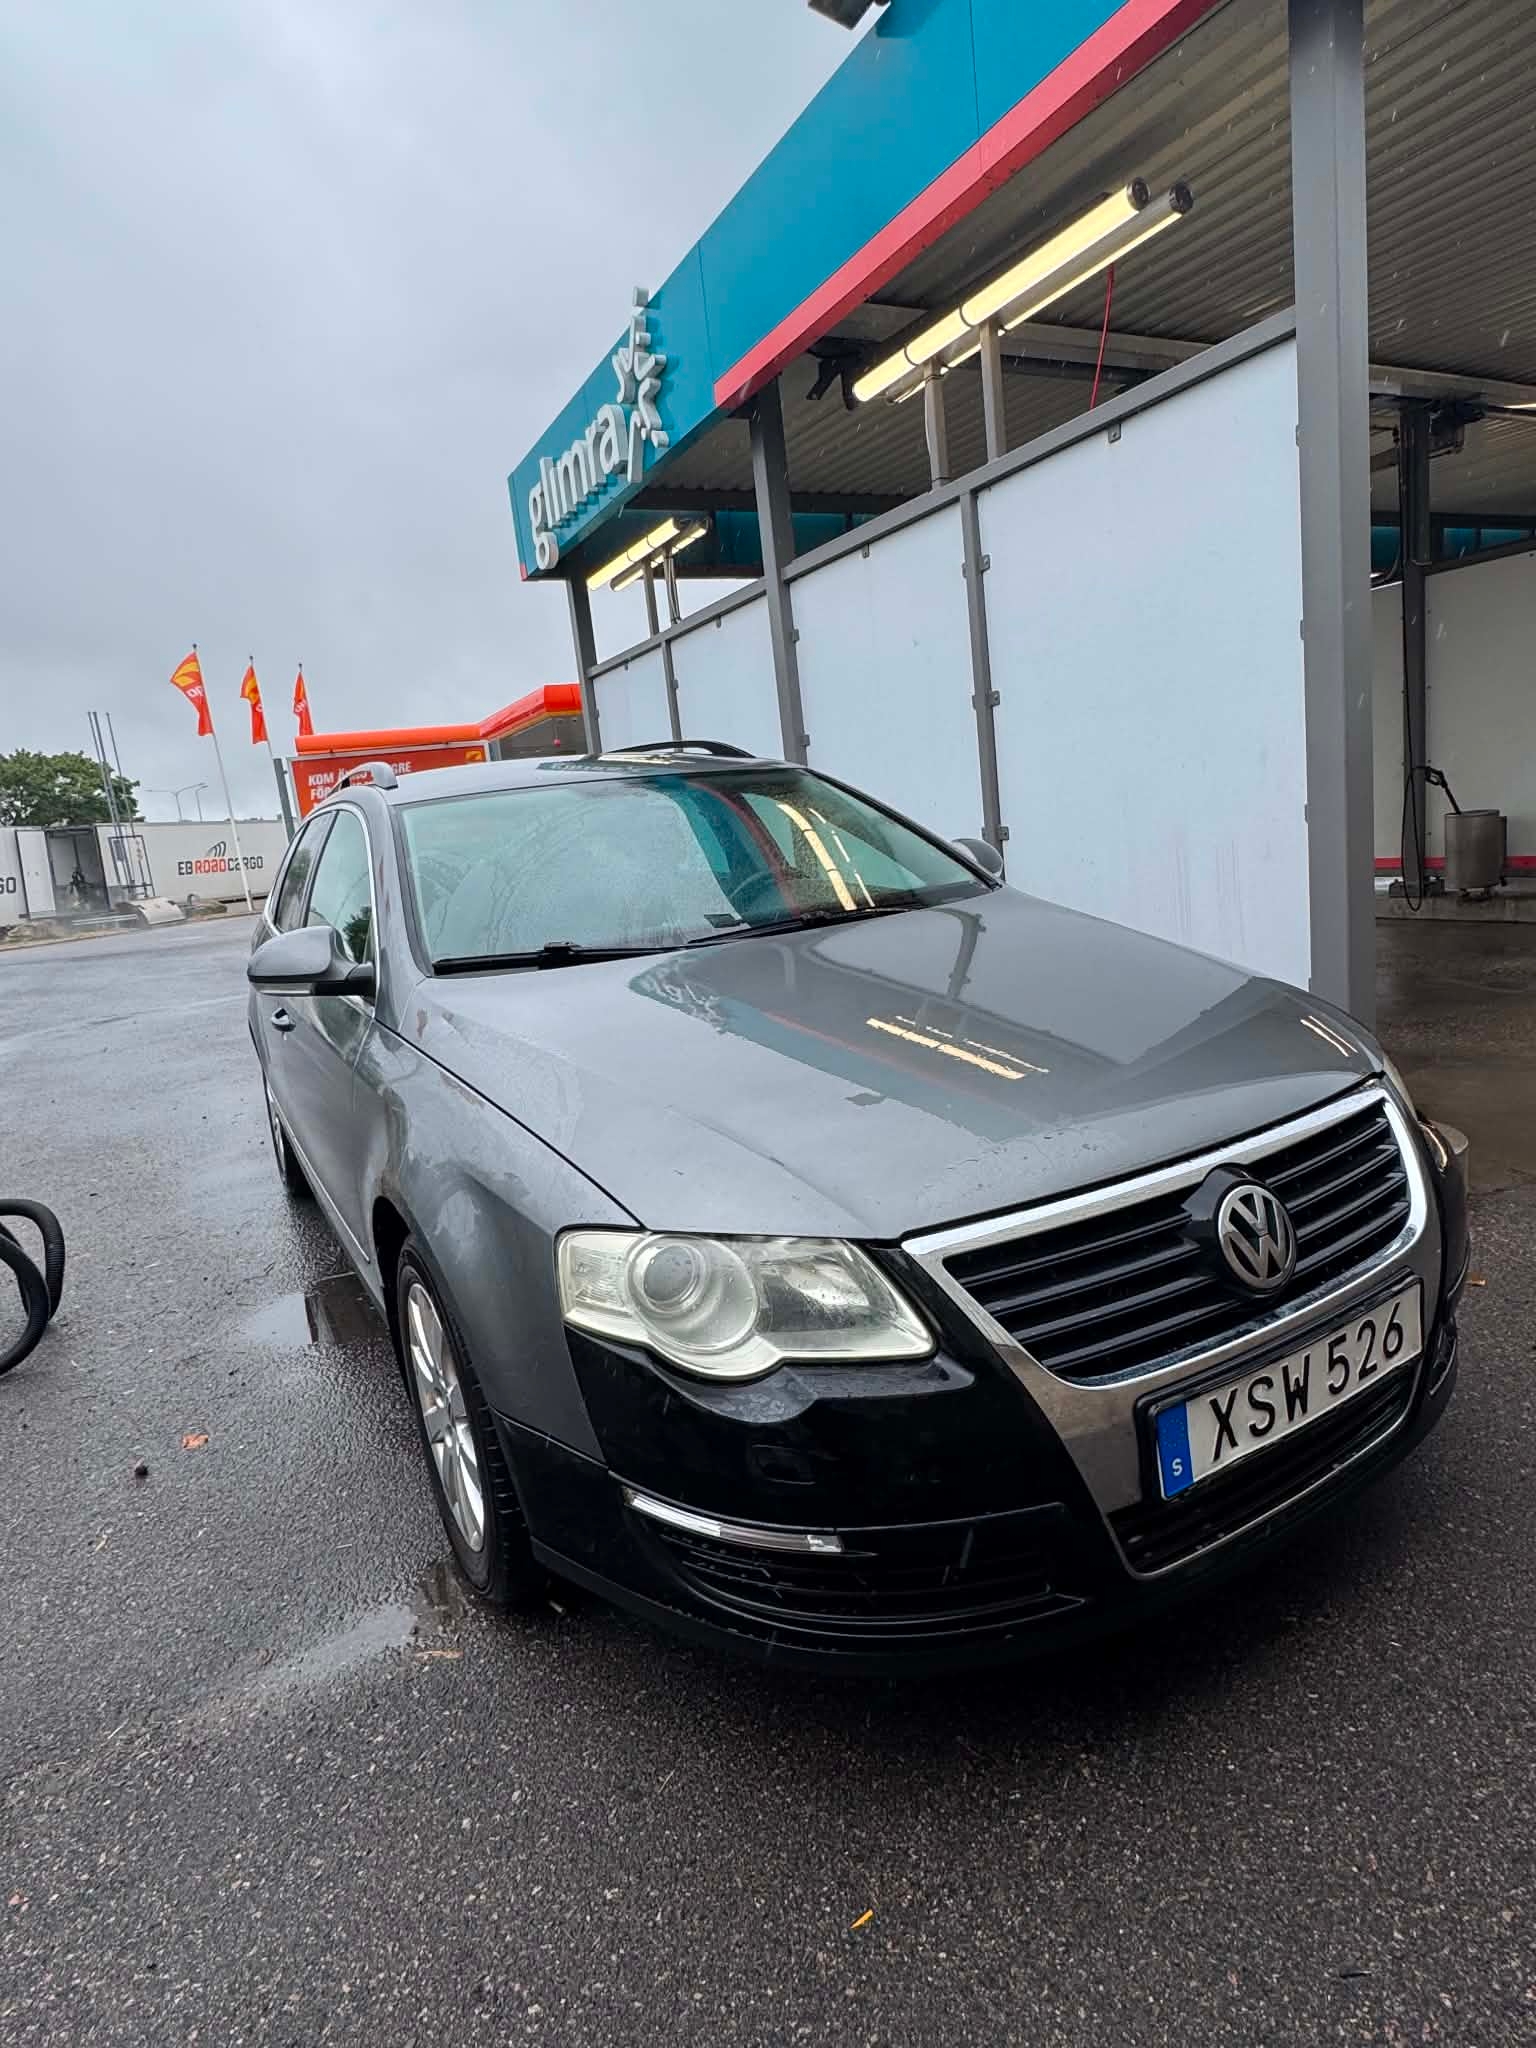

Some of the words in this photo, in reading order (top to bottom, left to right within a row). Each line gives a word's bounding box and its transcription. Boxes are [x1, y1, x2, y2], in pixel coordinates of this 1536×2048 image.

[529, 403, 629, 570] glimra
[308, 772, 334, 786] KOM
[1209, 1354, 1310, 1464] XSW
[1327, 1303, 1404, 1395] 526
[1172, 1458, 1183, 1477] S
